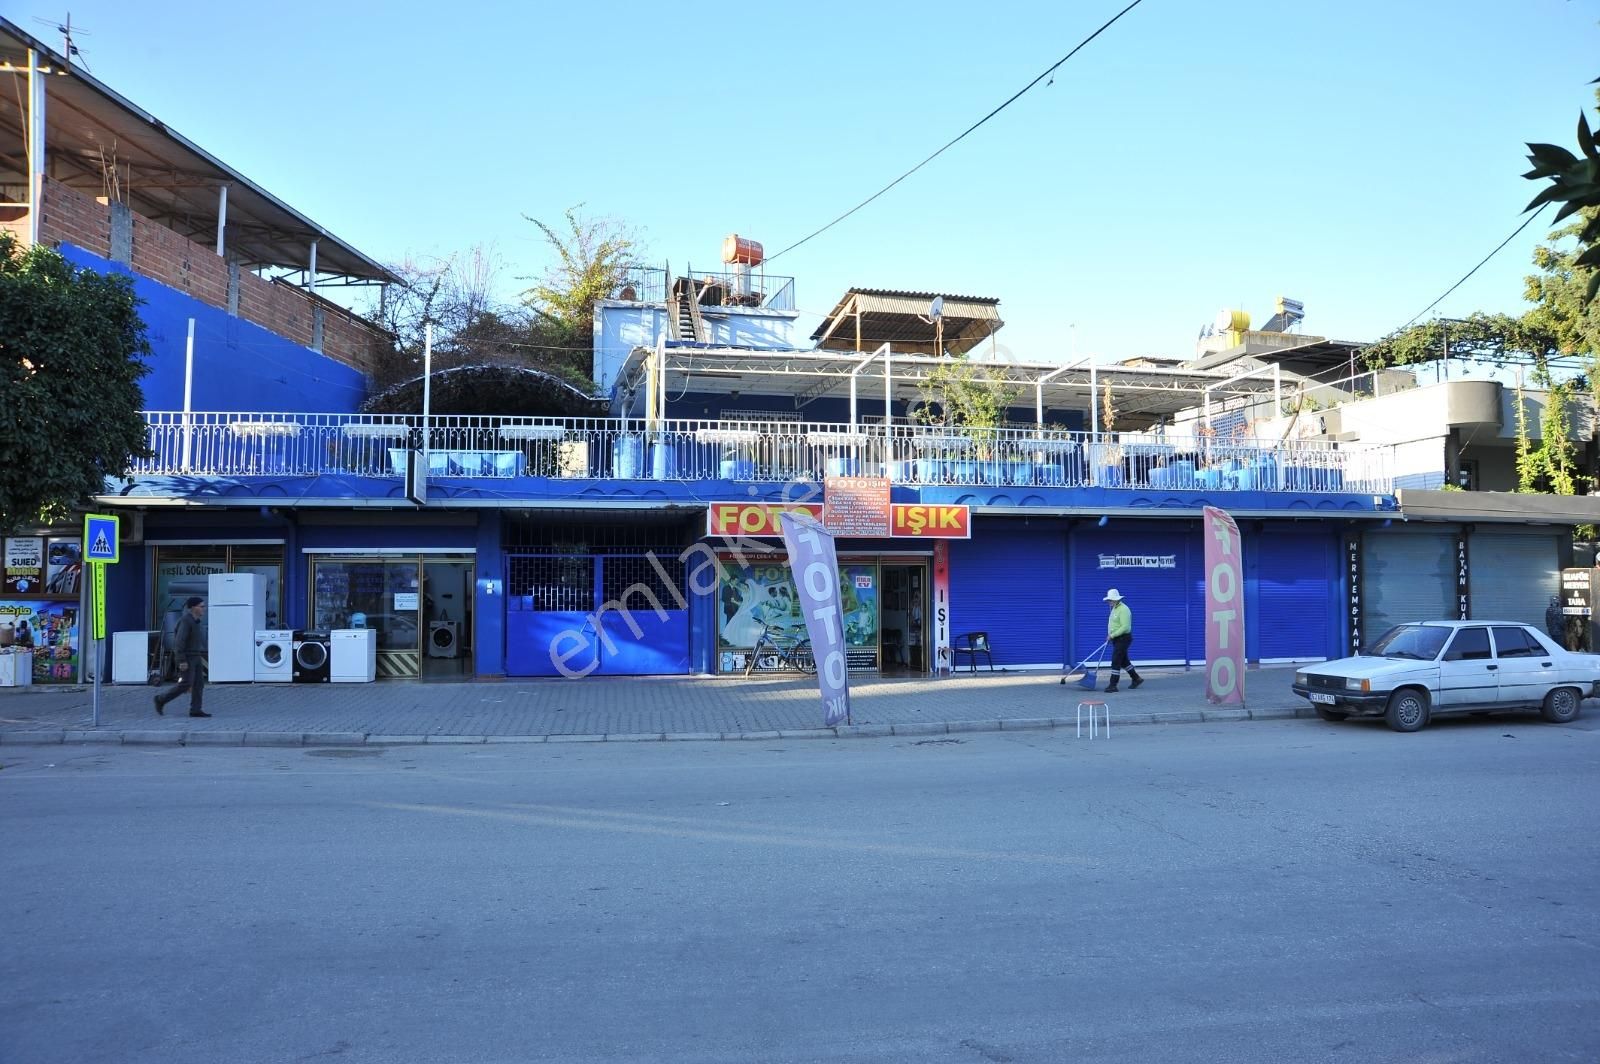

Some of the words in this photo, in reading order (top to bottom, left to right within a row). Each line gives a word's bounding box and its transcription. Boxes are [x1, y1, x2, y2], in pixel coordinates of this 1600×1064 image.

[828, 480, 868, 489] FOTO
[897, 507, 961, 535] IŞIK
[11, 558, 37, 566] SUIED
[1116, 557, 1143, 566] KİRALIK
[1459, 542, 1467, 585] BAYAN
